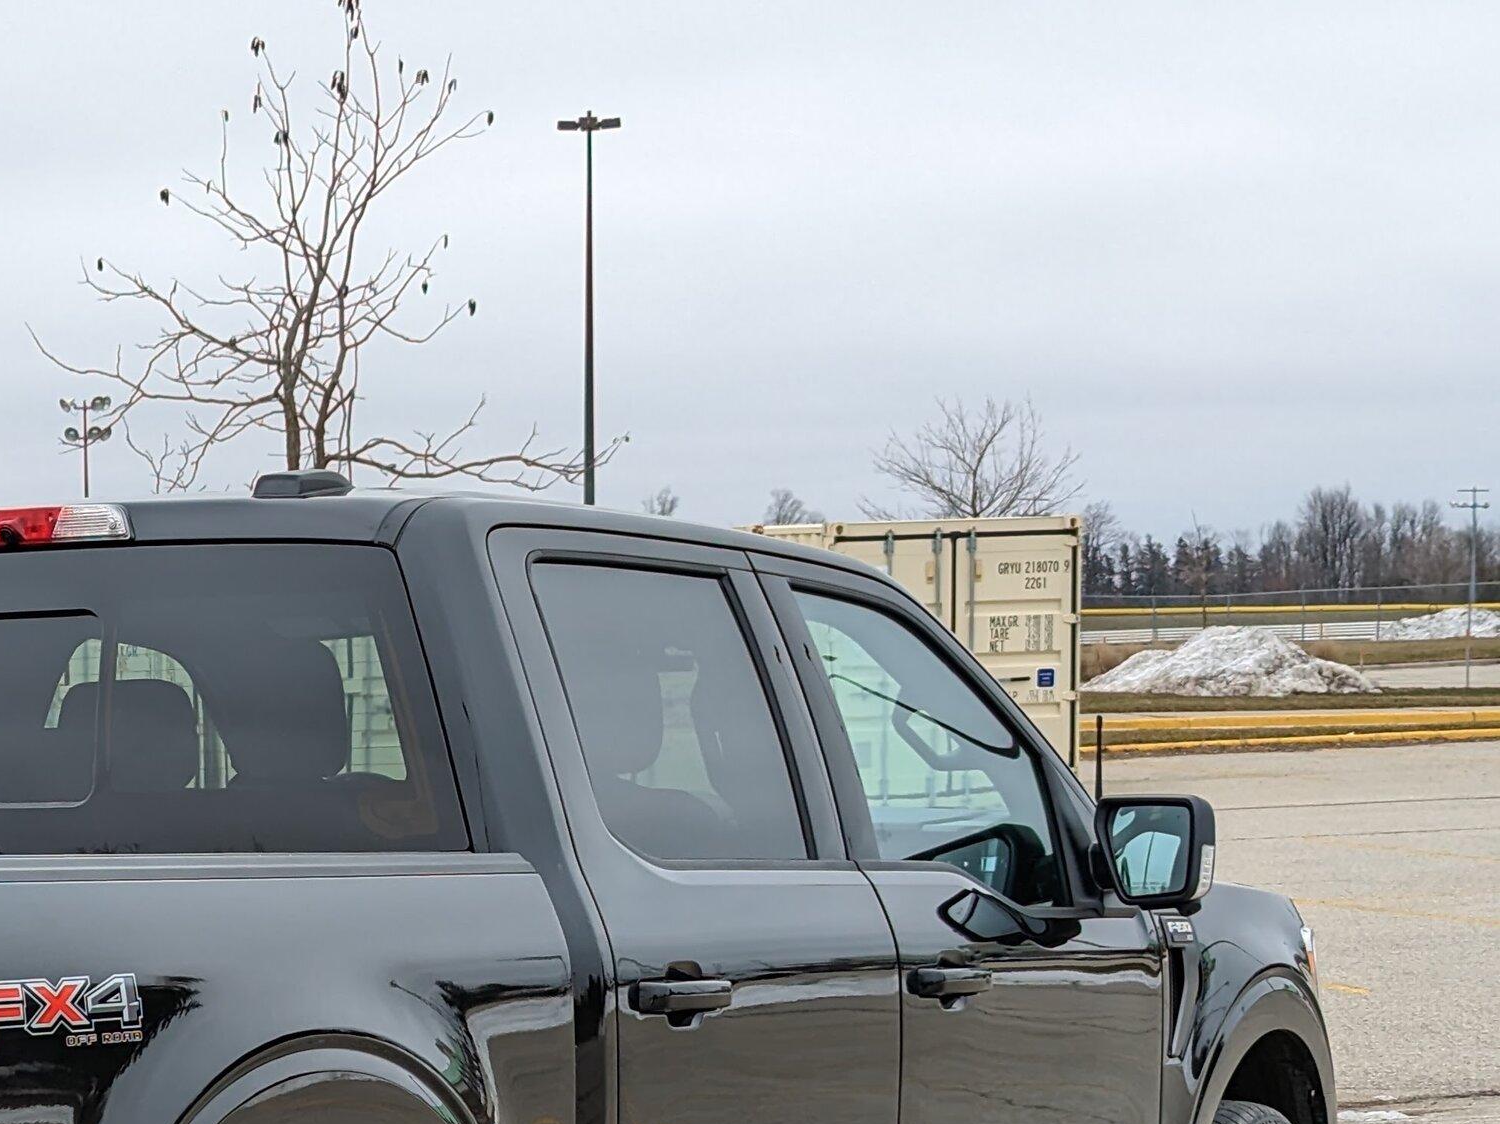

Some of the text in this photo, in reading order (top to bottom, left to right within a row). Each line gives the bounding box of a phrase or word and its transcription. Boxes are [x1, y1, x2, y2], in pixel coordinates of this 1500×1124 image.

[998, 560, 1070, 574] GRYU 218070 9
[1025, 577, 1046, 589] 22G1
[990, 628, 1009, 640] TARE
[989, 640, 1004, 652] NET
[66, 1031, 143, 1047] OFF ROAD
